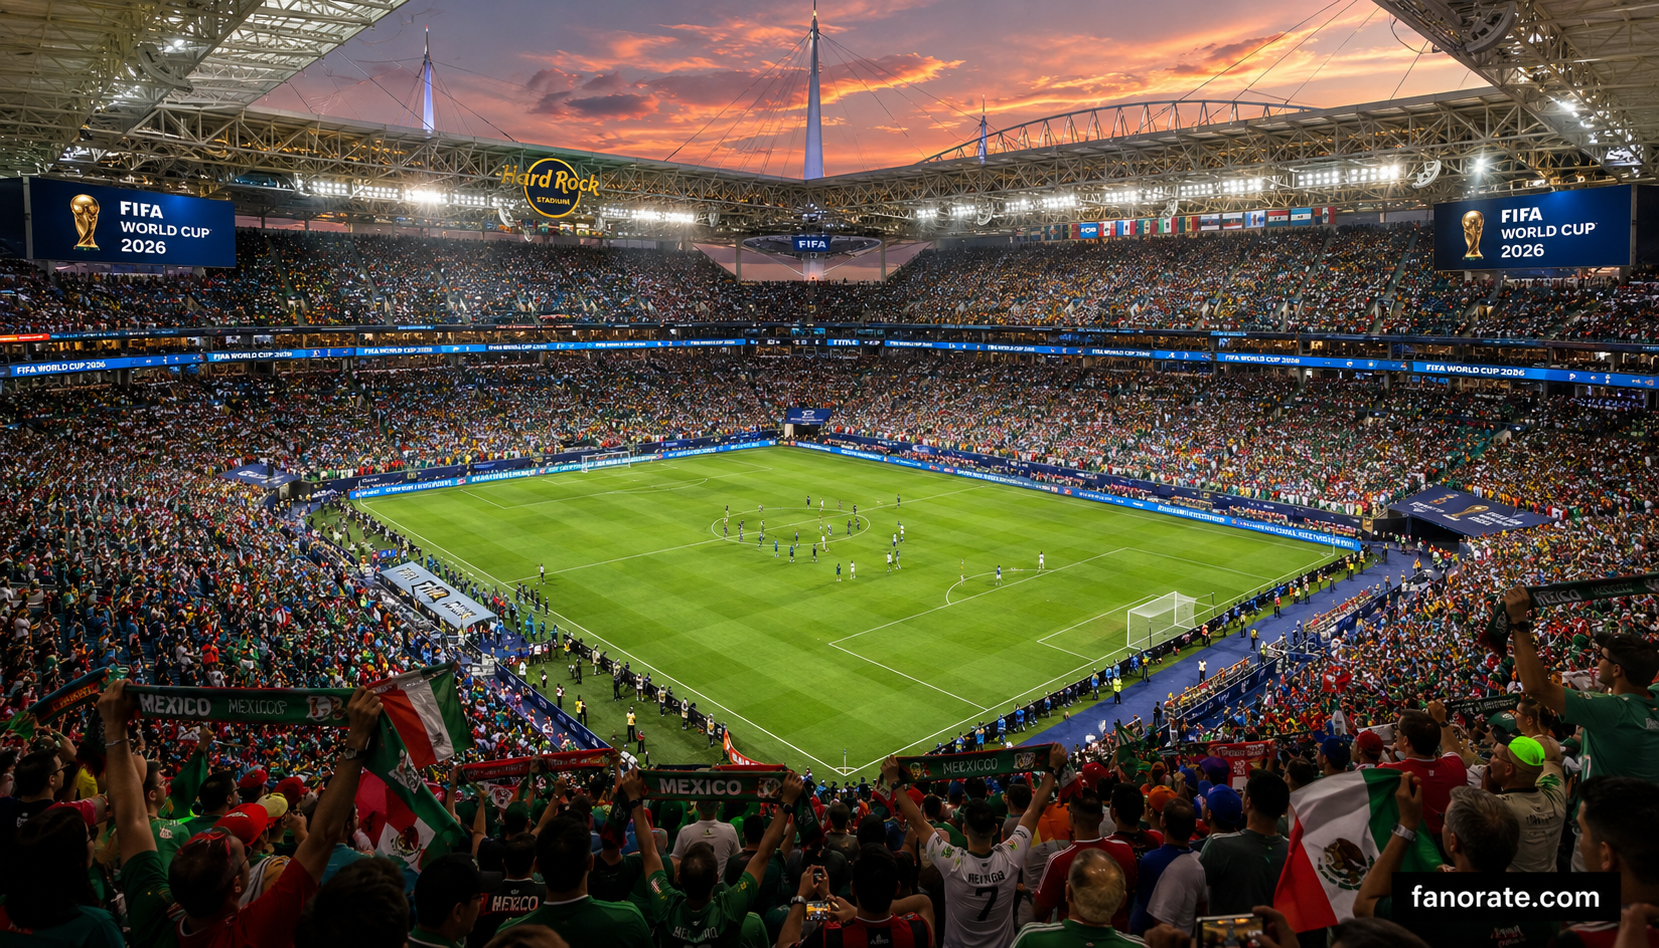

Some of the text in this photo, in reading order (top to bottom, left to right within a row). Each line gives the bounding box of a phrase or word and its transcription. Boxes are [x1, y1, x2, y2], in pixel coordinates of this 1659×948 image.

[498, 164, 600, 196] Hard Rock
[120, 200, 163, 219] FIFA
[1501, 206, 1543, 223] FIFA
[120, 220, 210, 238] WORLD CUP
[1501, 222, 1596, 239] WORLD CUP
[121, 238, 166, 254] 2026
[798, 240, 827, 248] FIFA
[1501, 243, 1544, 258] 2026
[17, 366, 36, 374] FIFA
[37, 363, 68, 372] WORLD
[69, 361, 85, 370] CUP
[1426, 364, 1446, 372] FIFA
[1447, 366, 1479, 374] WORLD
[1480, 367, 1499, 375] CUP
[139, 693, 211, 716] MEXICO
[659, 778, 742, 795] MEXICO
[975, 886, 998, 921] 7
